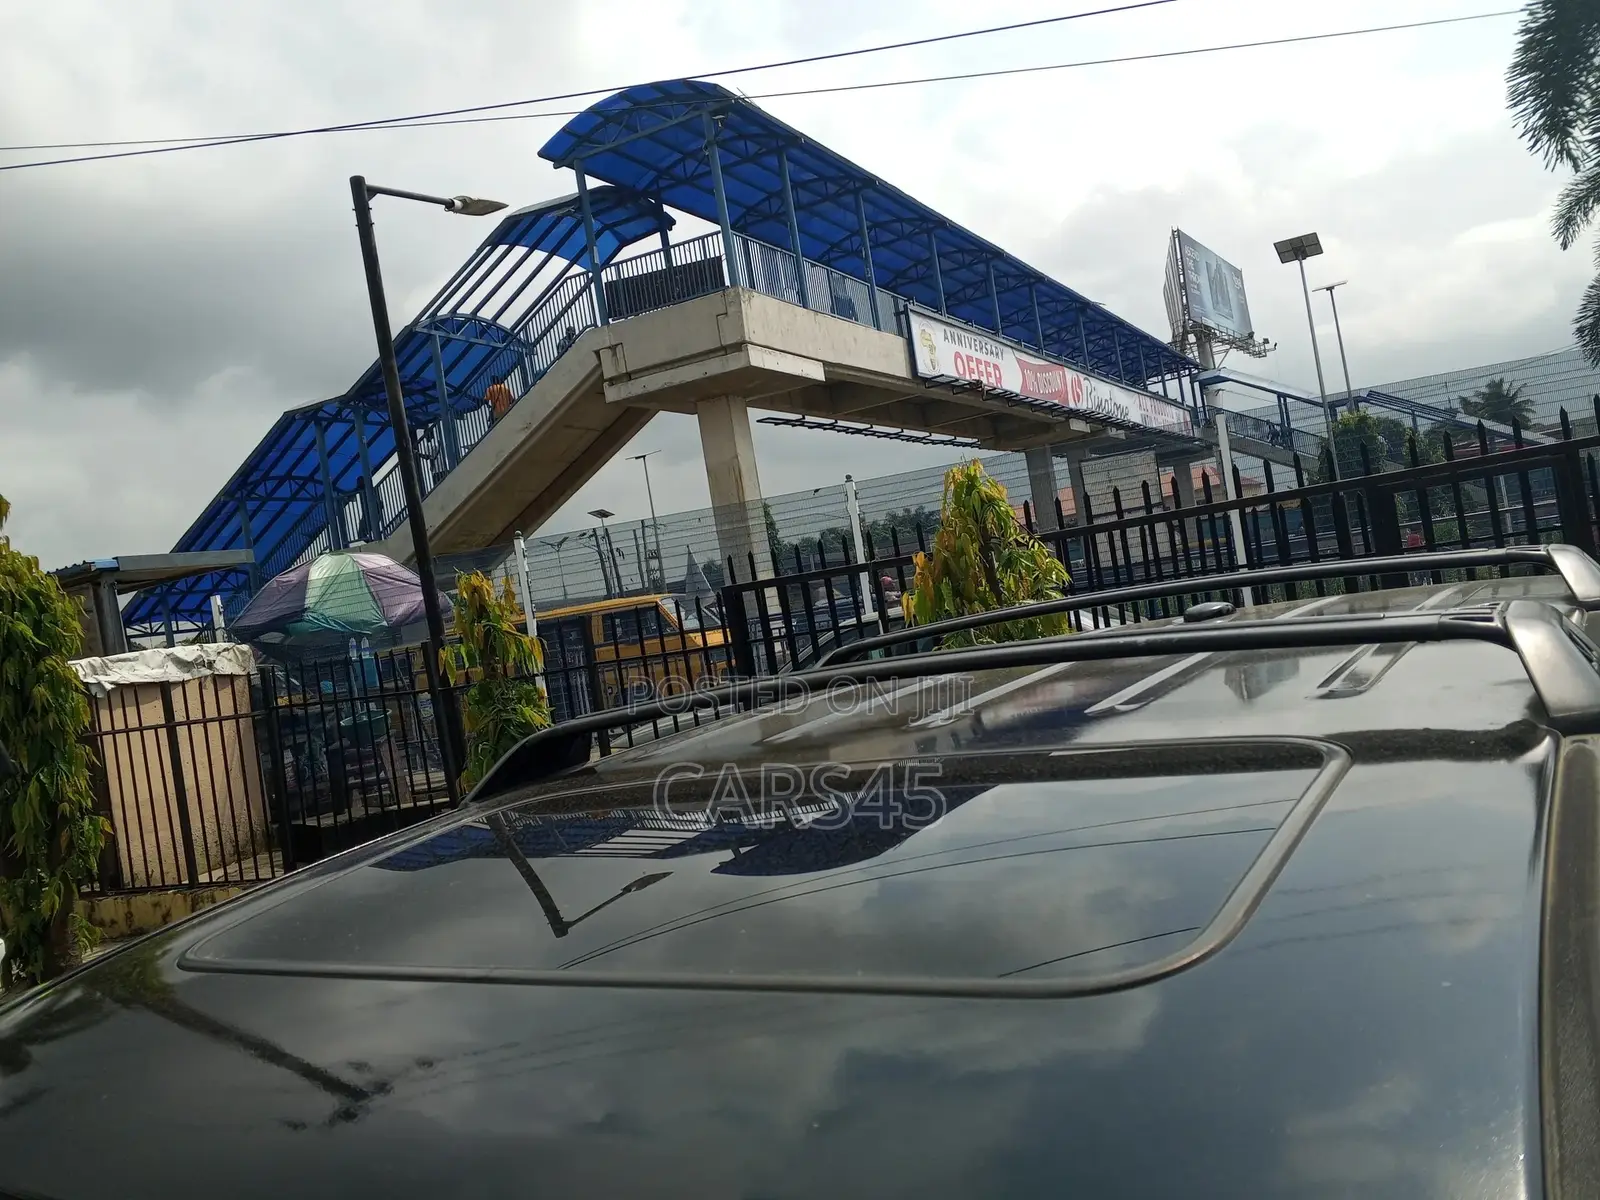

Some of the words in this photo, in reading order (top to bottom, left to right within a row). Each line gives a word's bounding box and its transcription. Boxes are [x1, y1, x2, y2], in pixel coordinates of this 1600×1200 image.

[943, 328, 1004, 361] ANNIVERSARY
[953, 351, 1003, 389] OFFER
[1037, 370, 1063, 394] DISCOUNT
[1083, 377, 1130, 420] Binatone
